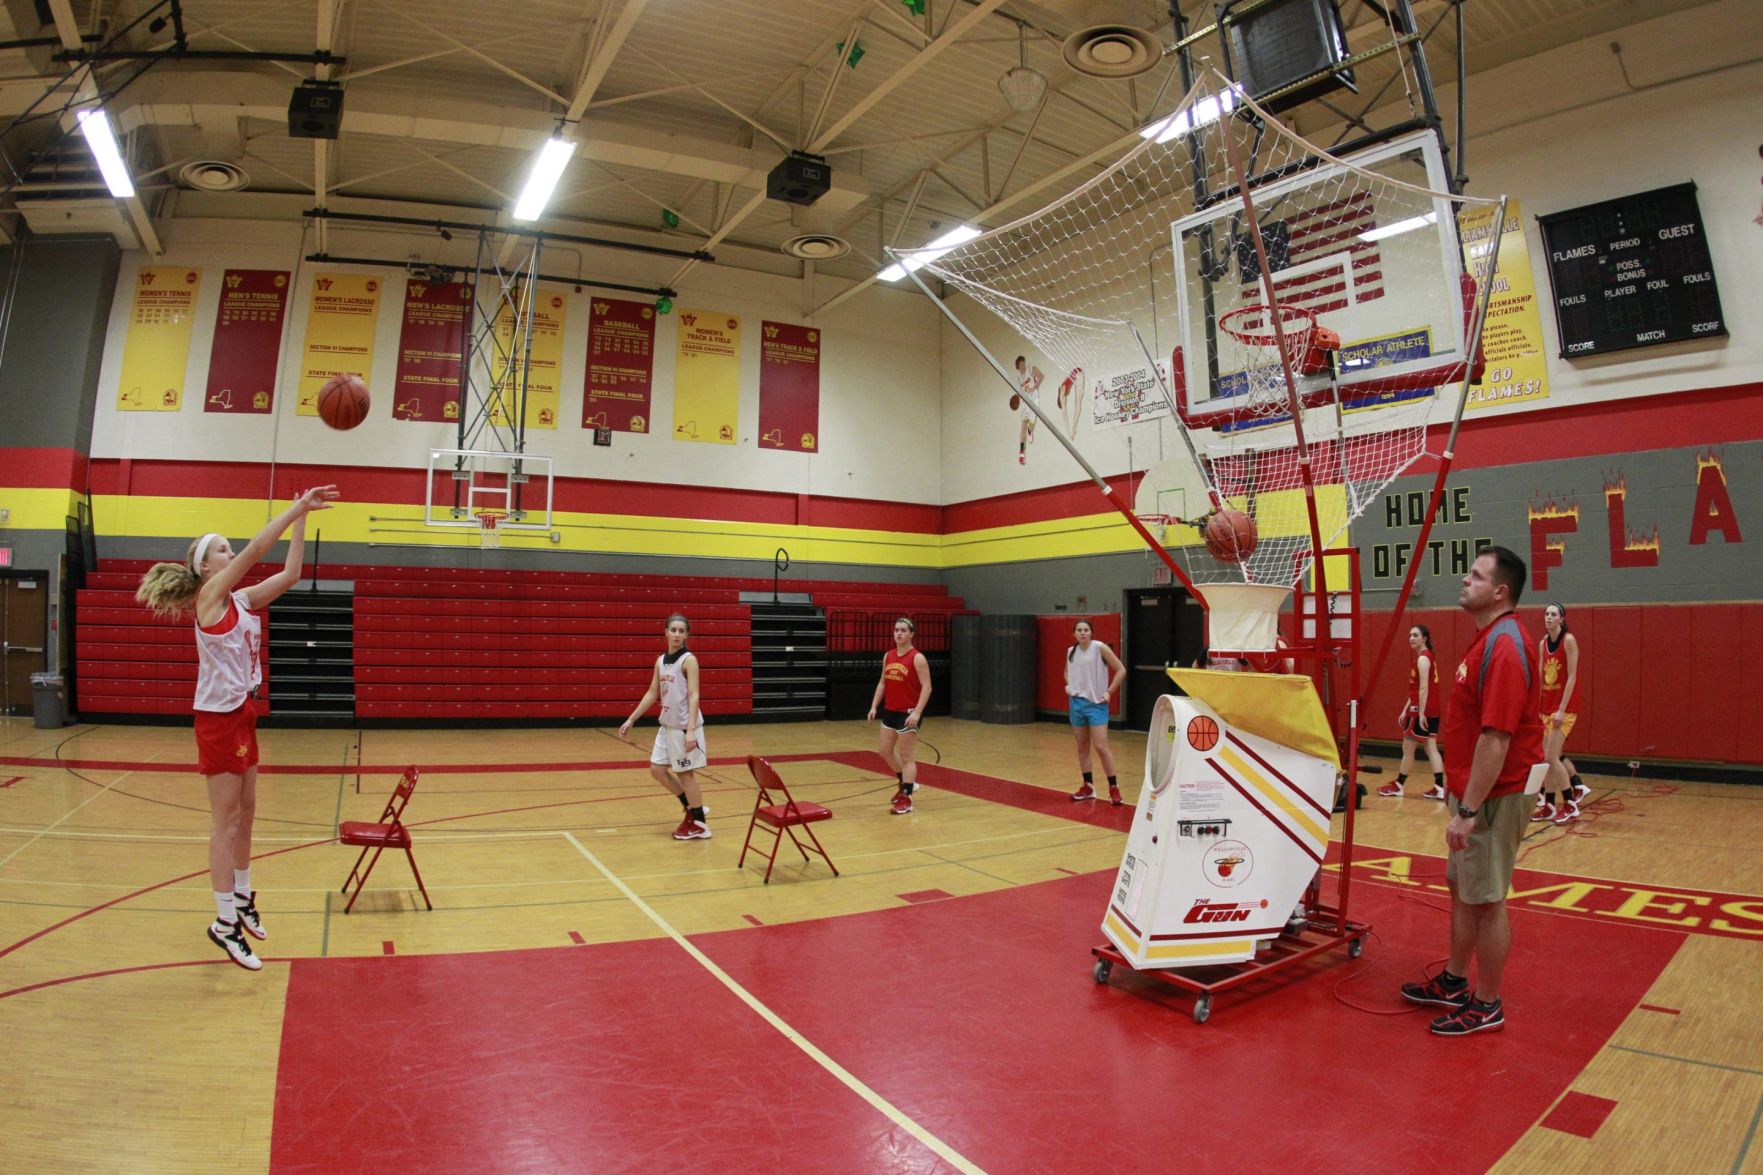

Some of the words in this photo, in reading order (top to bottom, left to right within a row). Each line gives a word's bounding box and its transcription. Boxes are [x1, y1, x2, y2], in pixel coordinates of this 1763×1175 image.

[1658, 223, 1696, 241] GUEST
[1609, 238, 1641, 251] PERIOD
[1553, 244, 1597, 263] FLAMES
[1616, 259, 1643, 271] POSS.
[1616, 268, 1647, 283] BONUS
[1682, 272, 1712, 286] FOULS
[1646, 279, 1671, 292] FOUL
[252, 293, 279, 301] TENNIS
[1604, 285, 1638, 299] PLAYER
[315, 296, 342, 304] WOMEN'S
[344, 298, 375, 306] LACROSSE
[1559, 294, 1587, 308] FOULS
[604, 319, 640, 330] BASEBALL
[593, 327, 616, 335] LEAGUE
[616, 330, 650, 339] CHAMPIONS
[687, 333, 707, 341] TRACK
[696, 328, 724, 337] WOMEN'S
[1490, 331, 1510, 340] players
[1636, 330, 1667, 343] MATCH
[764, 341, 780, 349] MEN'S
[1342, 345, 1384, 361] SCHOLAR
[1386, 336, 1426, 353] ATHLETE
[1488, 339, 1510, 348] coaches
[1567, 341, 1596, 353] SCORE
[703, 346, 736, 355] CHAMPIONS
[766, 350, 785, 358] LEAGUE
[785, 352, 816, 361] CHAMPIONS
[1485, 345, 1508, 356] officials
[590, 364, 614, 372] SECTION
[618, 366, 647, 376] CHAMPIONS
[1491, 367, 1513, 383] GO
[1136, 378, 1156, 391] State
[591, 389, 609, 397] STATE
[609, 391, 627, 399] FINAL
[627, 392, 645, 400] FOUR
[1467, 379, 1542, 404] FLAMES!
[1130, 401, 1168, 415] Champions
[1385, 486, 1471, 529] HOME
[1373, 542, 1411, 579] OF
